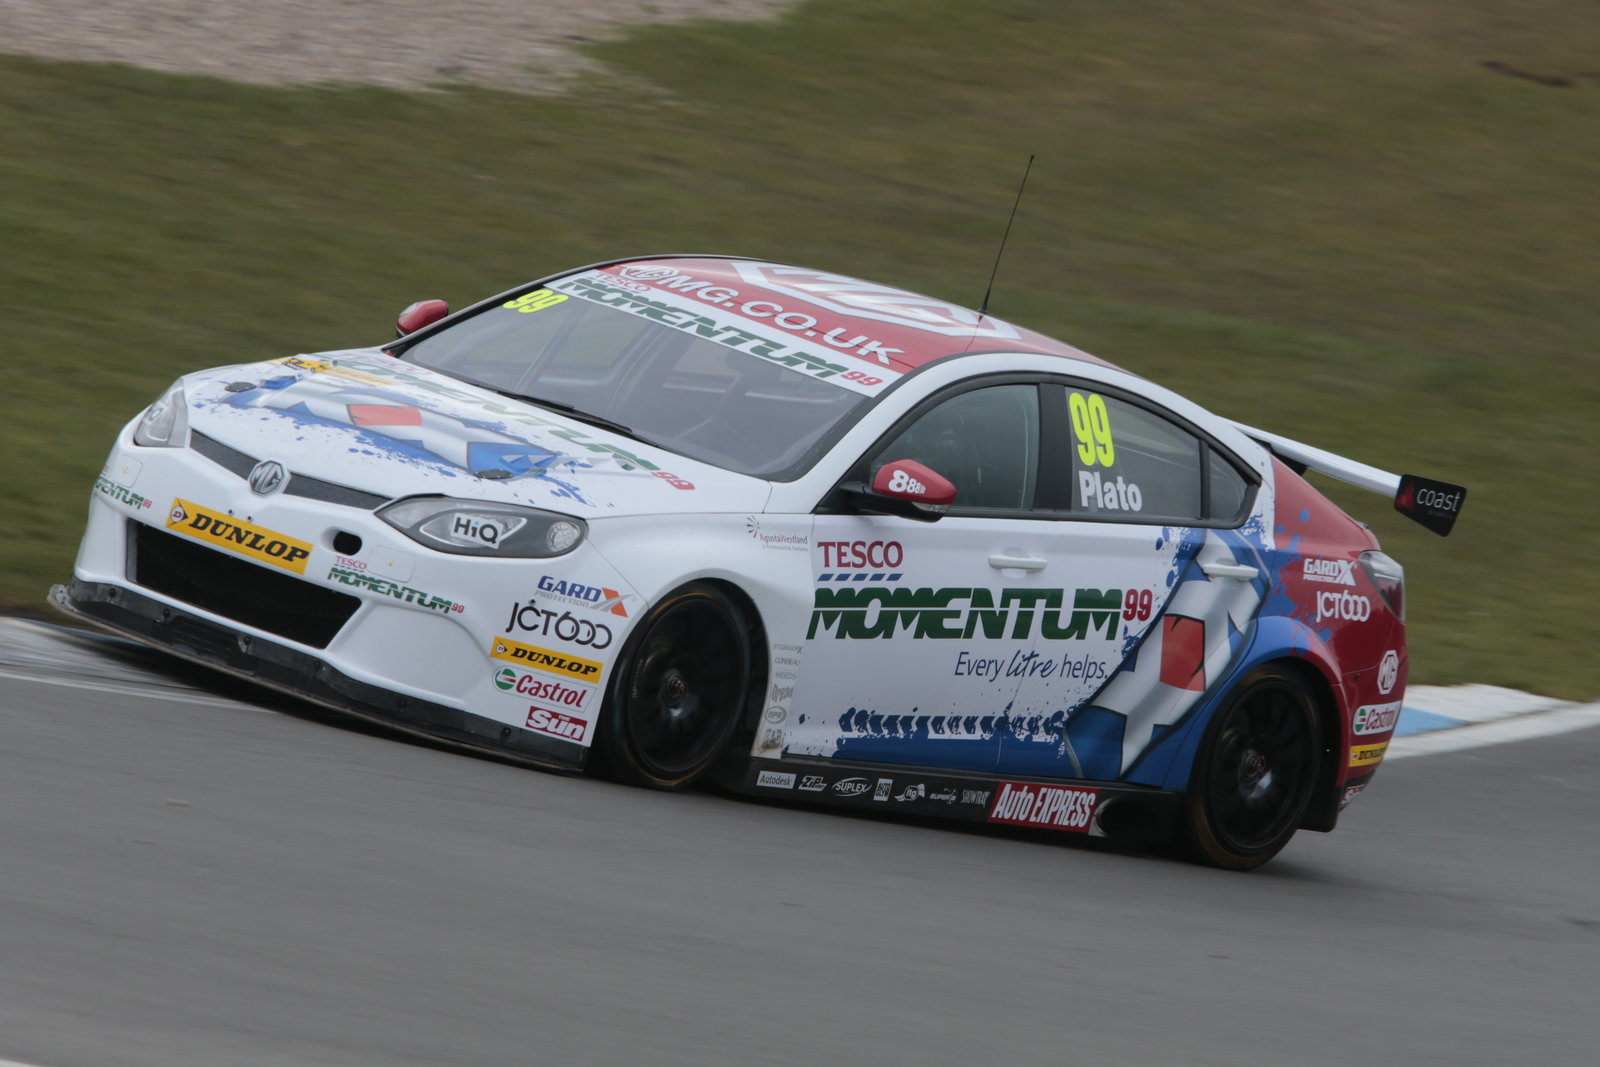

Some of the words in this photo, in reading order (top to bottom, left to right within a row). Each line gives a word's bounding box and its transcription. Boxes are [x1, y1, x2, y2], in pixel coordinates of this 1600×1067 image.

[596, 273, 652, 292] TESCO
[502, 289, 569, 314] 99
[655, 274, 906, 365] MG.CO.UK
[1069, 392, 1115, 468] 99
[1079, 470, 1142, 511] Plato
[1417, 488, 1460, 512] coast
[188, 513, 310, 563] DUNLOP
[454, 516, 498, 545] HiQ
[335, 556, 367, 571] TESCO
[817, 541, 903, 568] TESCO
[806, 587, 1123, 640] MOMENTUM
[1315, 590, 1370, 623] JCT600
[505, 601, 612, 650] JCT600
[511, 647, 598, 676] DUNLOP
[955, 651, 1005, 682] Every
[1006, 650, 1059, 678] litre
[1060, 654, 1108, 680] helps.
[516, 675, 588, 708] Castrol
[527, 709, 586, 740] Sun
[760, 774, 792, 787] Autodesk
[835, 781, 867, 793] SUPLEX
[992, 783, 1031, 821] Auto
[1029, 786, 1097, 828] EXPRESS
